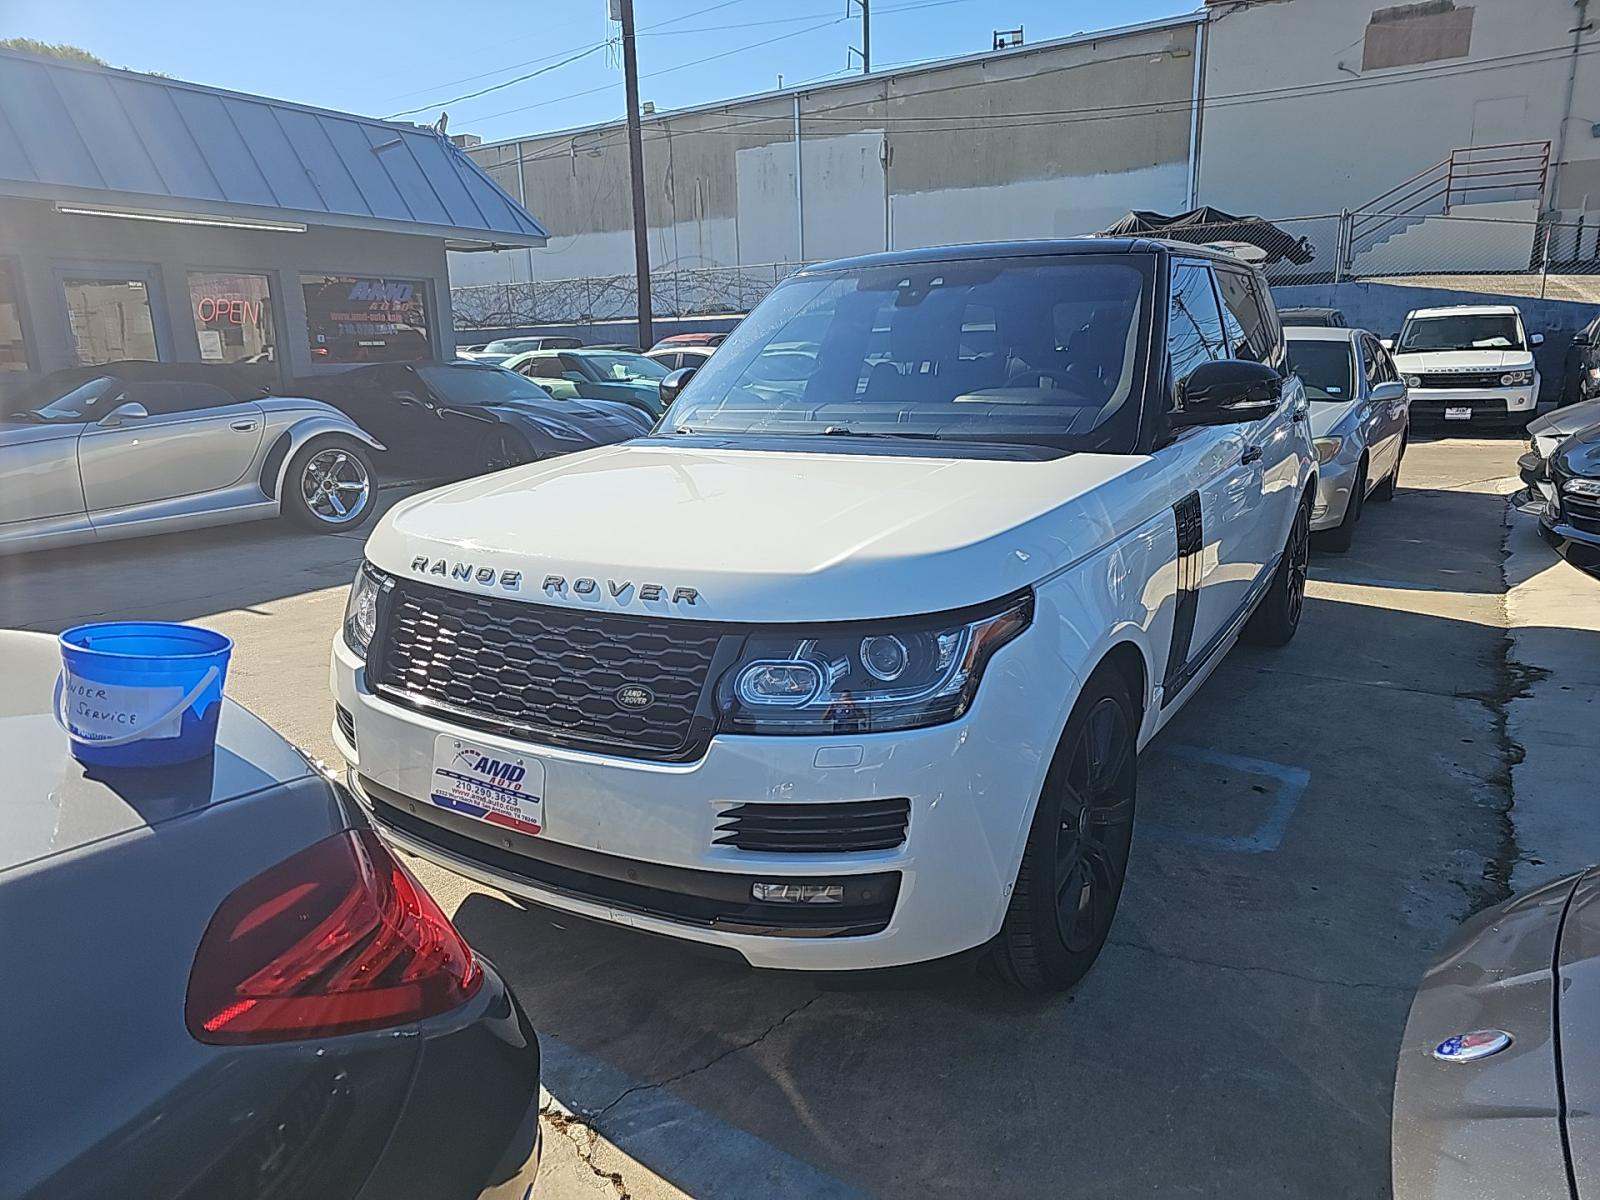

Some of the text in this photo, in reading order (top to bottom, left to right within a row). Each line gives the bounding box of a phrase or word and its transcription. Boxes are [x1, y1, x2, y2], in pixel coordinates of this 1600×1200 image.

[197, 297, 259, 327] OPEN
[410, 555, 698, 606] RANGE ROVER
[67, 685, 107, 700] NDER
[473, 755, 526, 782] AMD
[456, 780, 518, 806] 210.290.3623
[489, 777, 523, 791] AUTO
